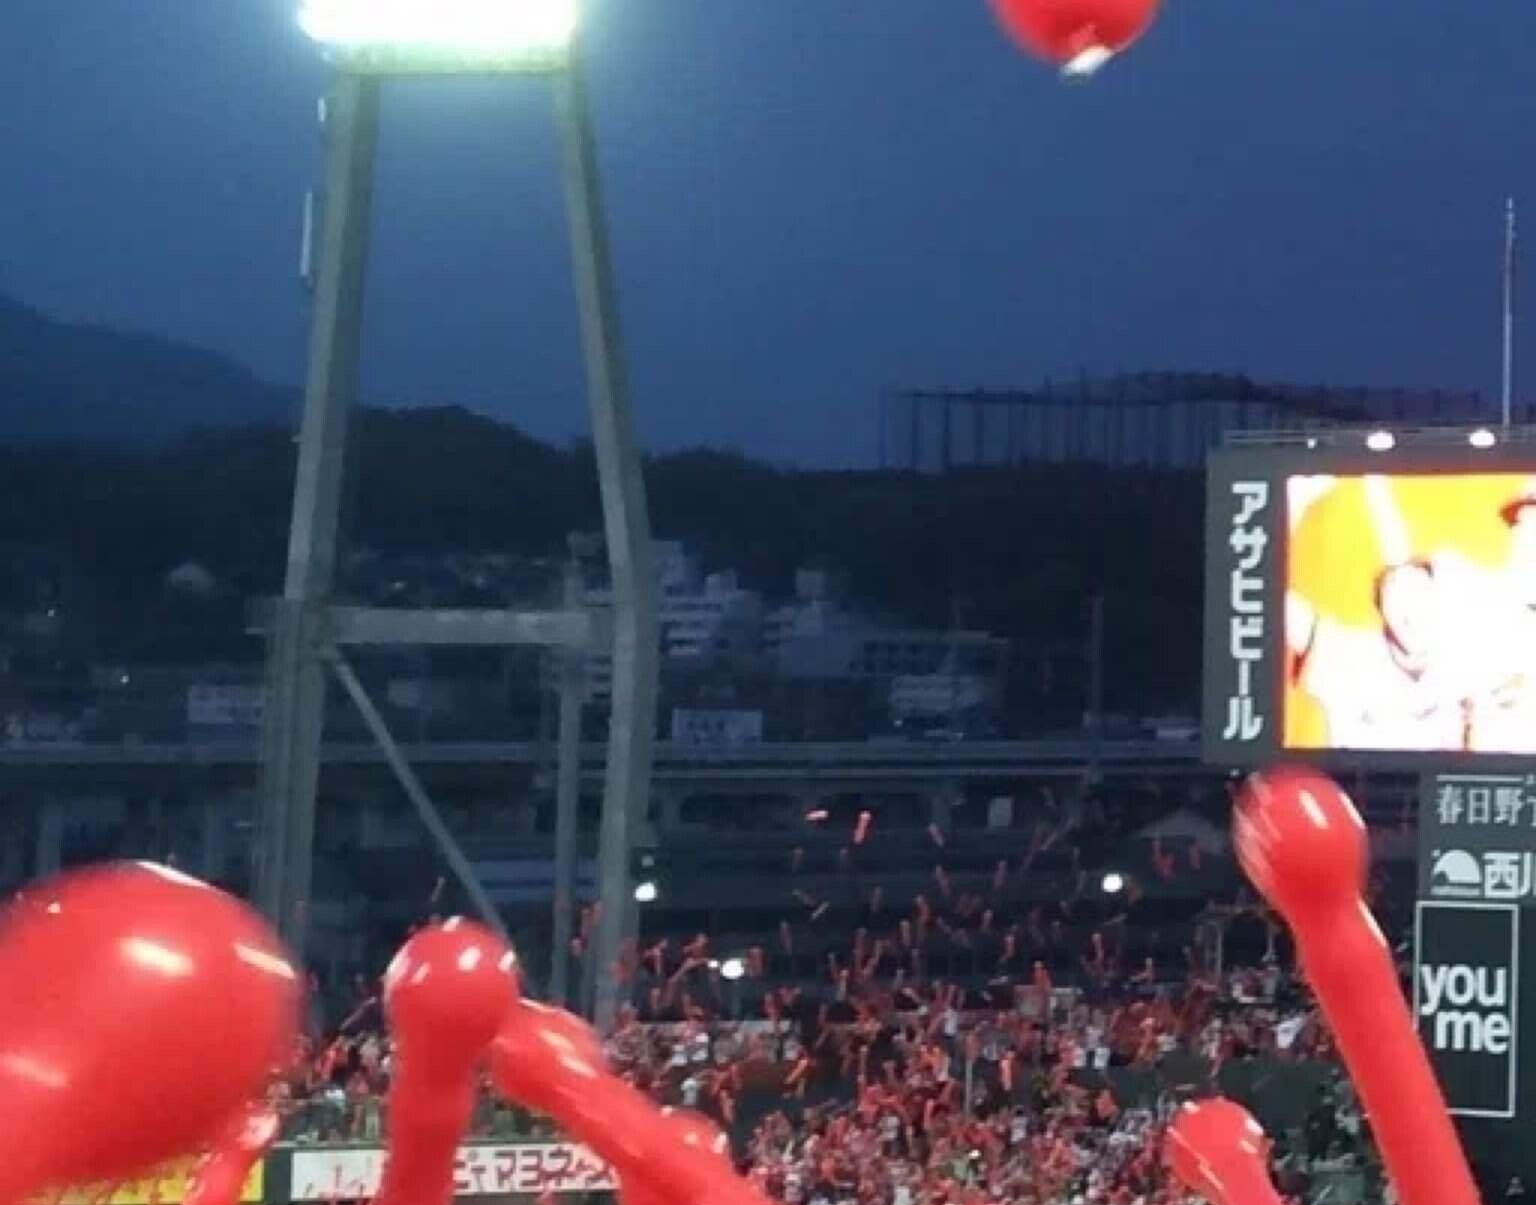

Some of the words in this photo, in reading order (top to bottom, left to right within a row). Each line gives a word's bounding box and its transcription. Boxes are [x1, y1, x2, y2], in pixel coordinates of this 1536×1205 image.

[1222, 480, 1269, 741] アサヒビール
[1437, 783, 1524, 828] 春日野
[1420, 963, 1506, 1015] you
[1434, 1010, 1511, 1054] me
